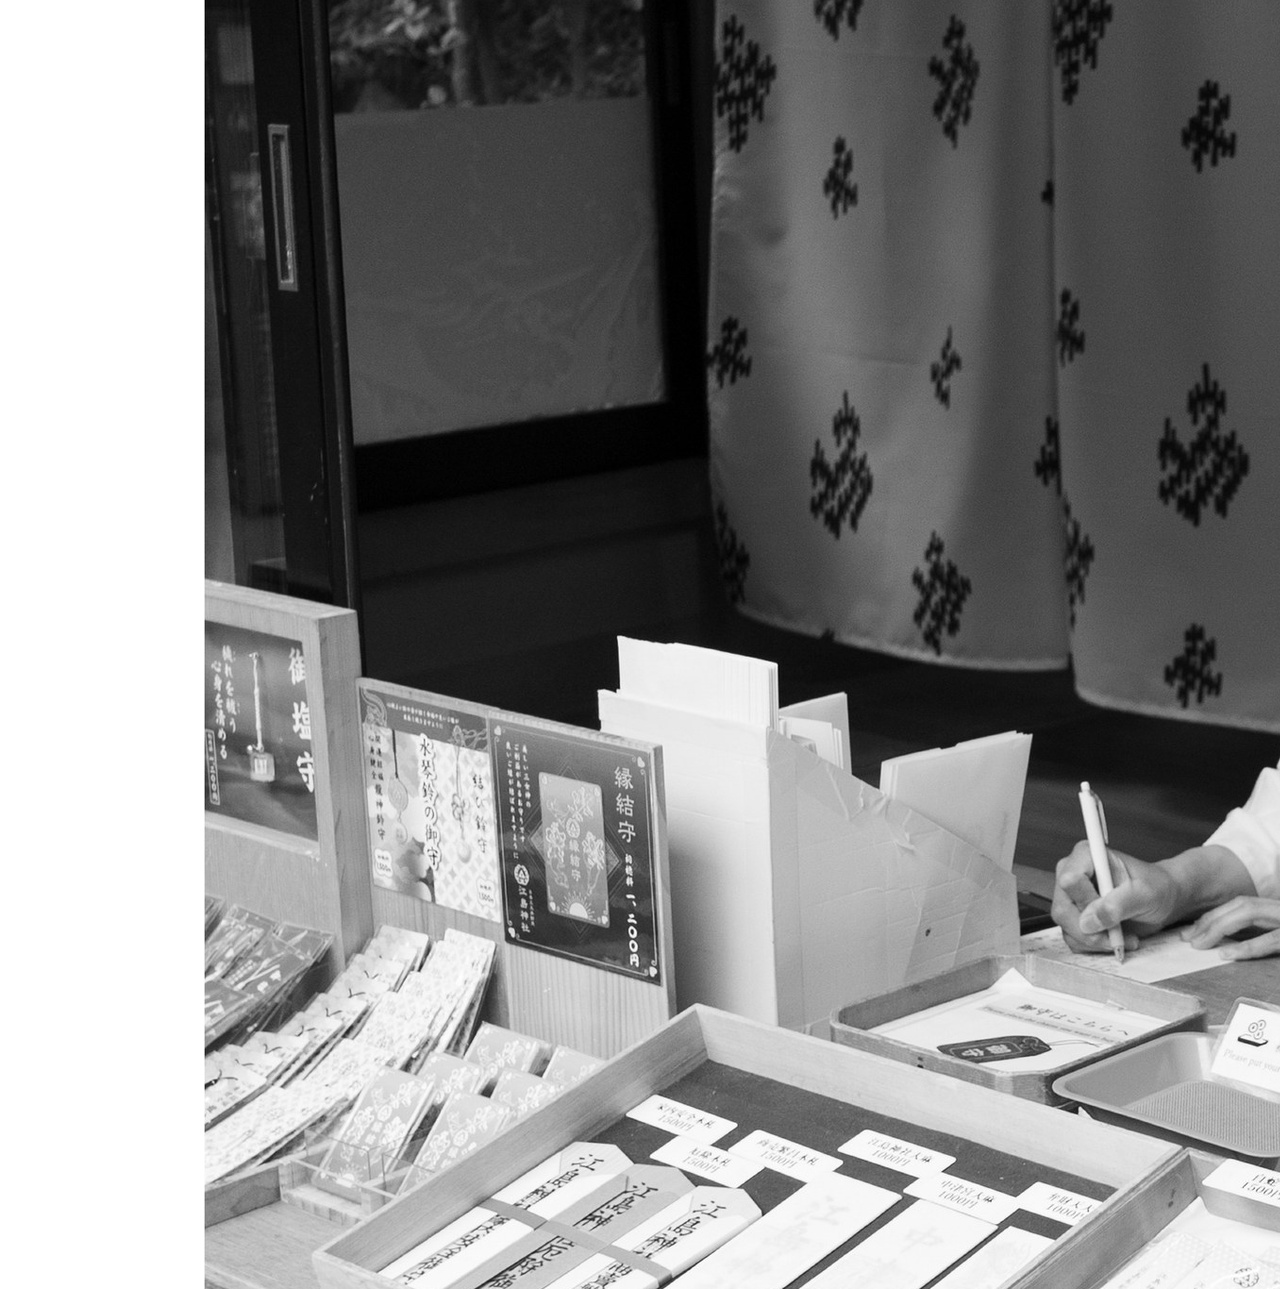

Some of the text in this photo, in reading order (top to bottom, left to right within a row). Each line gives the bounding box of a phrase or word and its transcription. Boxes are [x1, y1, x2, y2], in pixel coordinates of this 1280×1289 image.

[614, 766, 636, 843] 縁結守
[518, 886, 530, 933] 江島神社
[1224, 1048, 1248, 1063] Please
[1249, 1058, 1262, 1068] put
[1264, 1062, 1280, 1075] your
